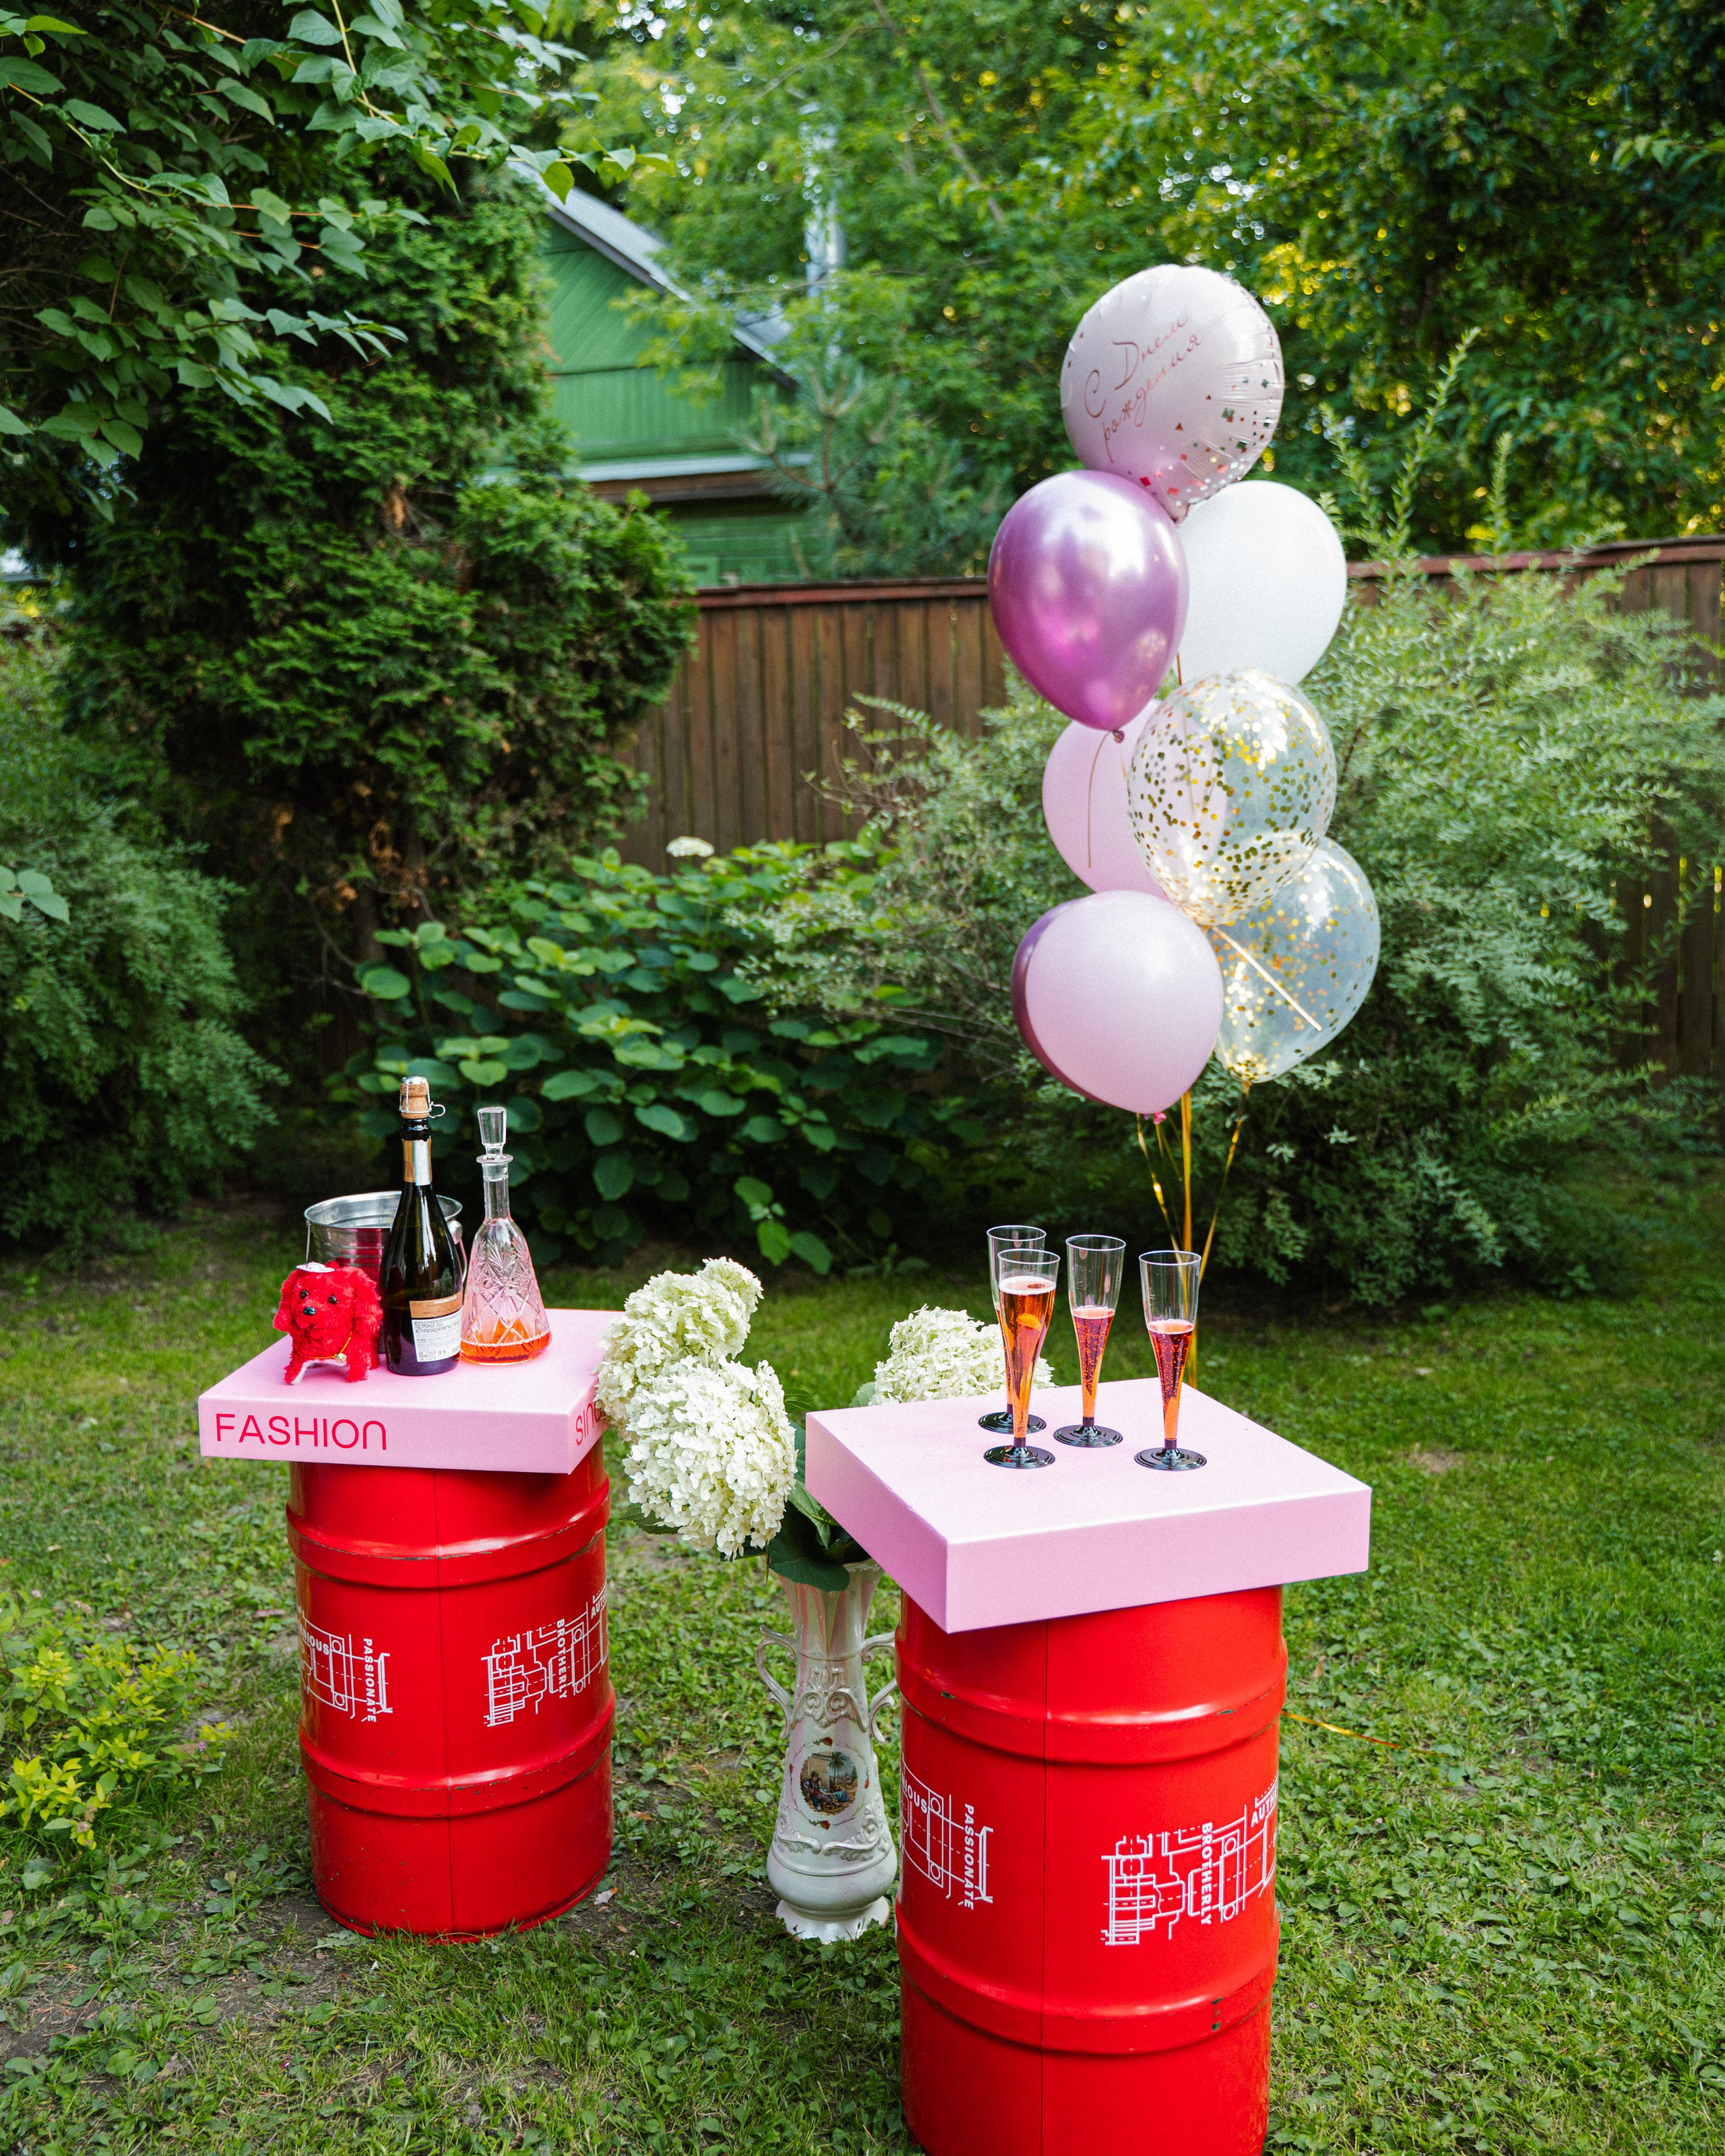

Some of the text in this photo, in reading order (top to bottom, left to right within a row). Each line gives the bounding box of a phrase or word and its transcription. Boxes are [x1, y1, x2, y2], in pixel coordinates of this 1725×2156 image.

[1084, 369, 1107, 418] С
[216, 1413, 387, 1451] FASHION
[591, 1593, 606, 1620] AUTH
[301, 1625, 330, 1655] NIOUS
[557, 1618, 567, 1699] BROTHERLY
[363, 1638, 377, 1723] PASSIONATE
[902, 1772, 927, 1814] NIOUS
[1251, 1784, 1277, 1827] AUTHE
[964, 1803, 974, 1910] PASSIONATE
[1201, 1821, 1213, 1925] BROTHERLY
